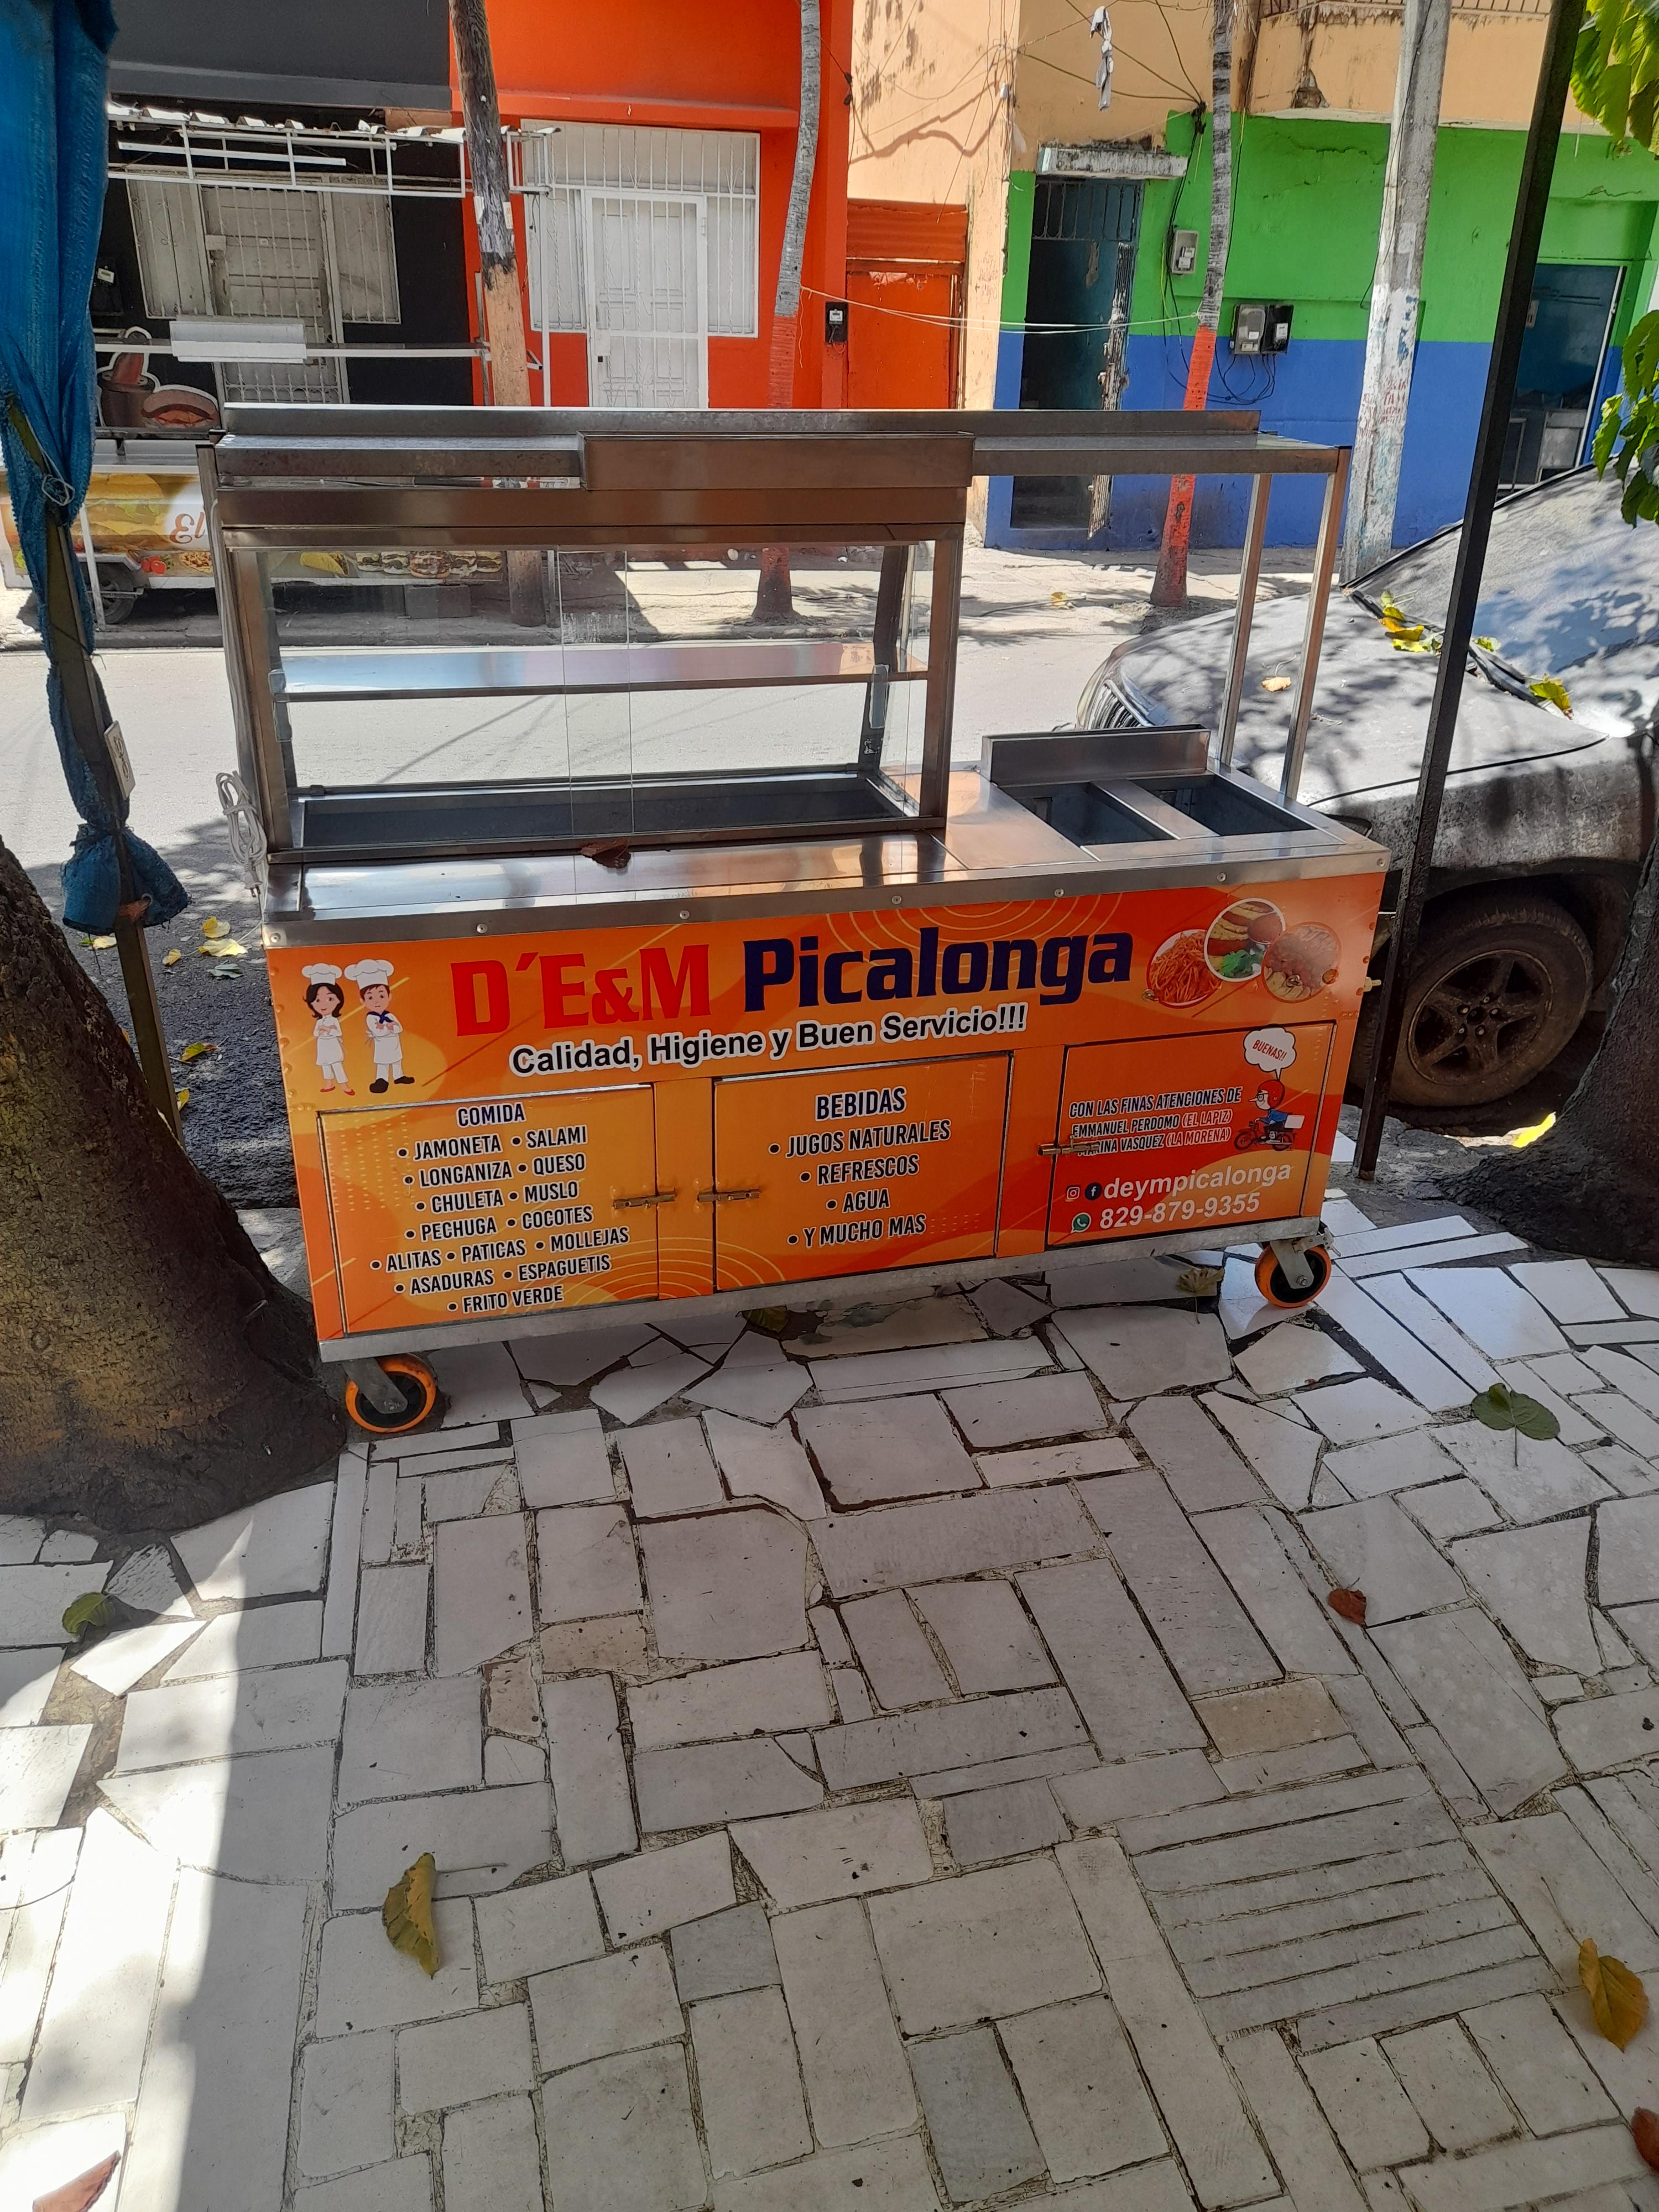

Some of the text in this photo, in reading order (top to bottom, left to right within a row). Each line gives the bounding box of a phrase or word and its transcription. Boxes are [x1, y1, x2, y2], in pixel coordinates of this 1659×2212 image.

[744, 927, 1133, 1012] Picalonga
[513, 1005, 1026, 1073] Calidad, Higiene y Buen Servicio!!!
[1252, 1039, 1287, 1061] BUENAS!!
[458, 1103, 525, 1126] COMIDA
[816, 1088, 905, 1120] BEBIDAS
[1070, 1087, 1242, 1118] CON LAS FINAS ATENCIONES DE
[786, 1120, 951, 1157] JUGOS NATURALES
[1072, 1109, 1233, 1138] EMMANUEL PERDOMO (EL LAPIZ)
[415, 1126, 587, 1160] JAMONETA SALAMI
[1120, 1134, 1164, 1152] VASQUEZ
[1166, 1132, 1182, 1147] (LA
[1185, 1128, 1232, 1145] MORENA)
[419, 1154, 585, 1187] LONGANIZA QUESO
[818, 1155, 919, 1185] REFRESCOS
[1104, 1164, 1292, 1201] deympicalonga
[431, 1181, 578, 1213] CHULETA MUSLO
[842, 1189, 890, 1212] AGUA
[1099, 1192, 1261, 1229] 829-879-9355
[421, 1206, 592, 1241] PECHUGA COCOTES
[804, 1214, 926, 1246] Y MUCHO MAS
[387, 1227, 629, 1271] ALITAS PATICAS MOLLEJAS
[411, 1255, 610, 1294] ASADURAS ESPAGUETIS
[463, 1285, 563, 1313] FRITO VERDE
